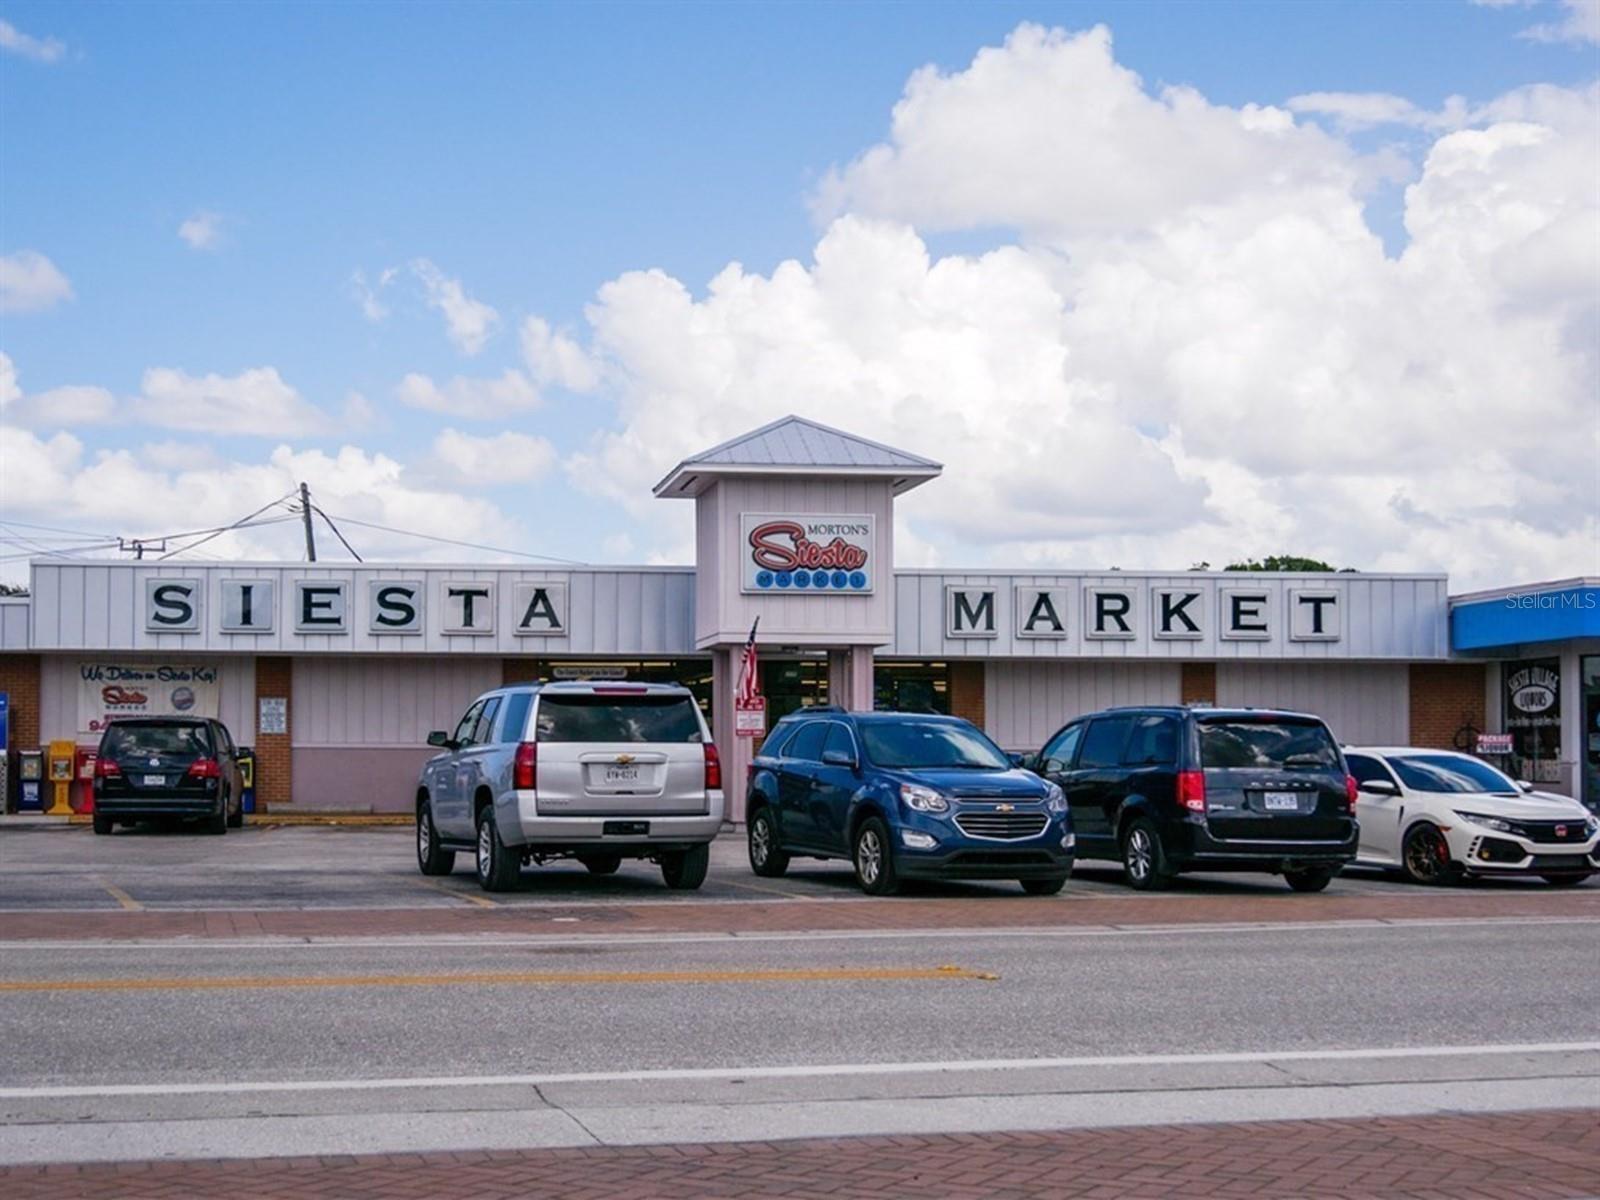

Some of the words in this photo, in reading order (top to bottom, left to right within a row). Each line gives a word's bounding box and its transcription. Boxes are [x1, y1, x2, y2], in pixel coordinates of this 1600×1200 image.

[807, 524, 869, 536] MORTON'S
[749, 520, 868, 572] Siesta
[756, 570, 867, 589] MARKET
[152, 584, 562, 628] SIESTA
[953, 591, 1336, 633] MARKET
[80, 666, 103, 681] We
[1508, 668, 1530, 695] SIESTA
[1531, 667, 1559, 693] VILLAGE
[1519, 691, 1547, 709] LIQUORS
[1477, 734, 1512, 743] PACKAGE
